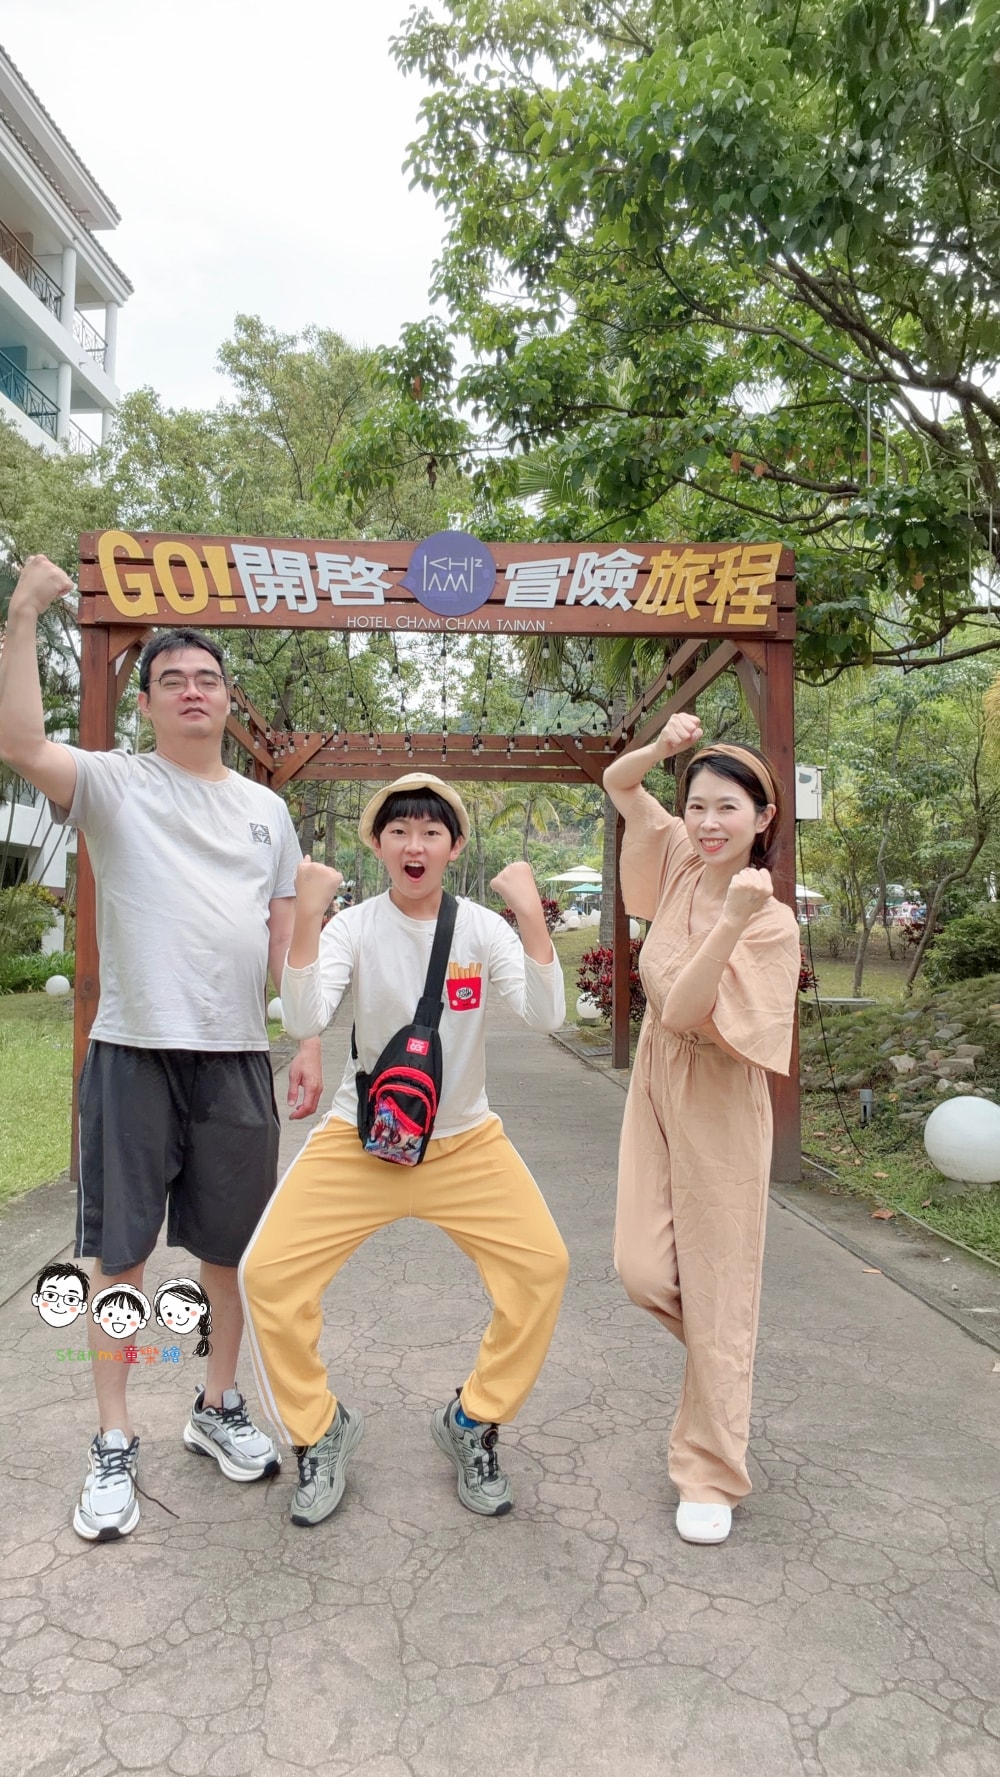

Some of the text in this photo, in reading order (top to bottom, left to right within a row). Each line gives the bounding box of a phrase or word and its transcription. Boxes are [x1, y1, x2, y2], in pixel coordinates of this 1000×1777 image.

[504, 543, 782, 625] 冒險旅程
[347, 616, 546, 632] HOTEL CHAM CHAM TAINAN
